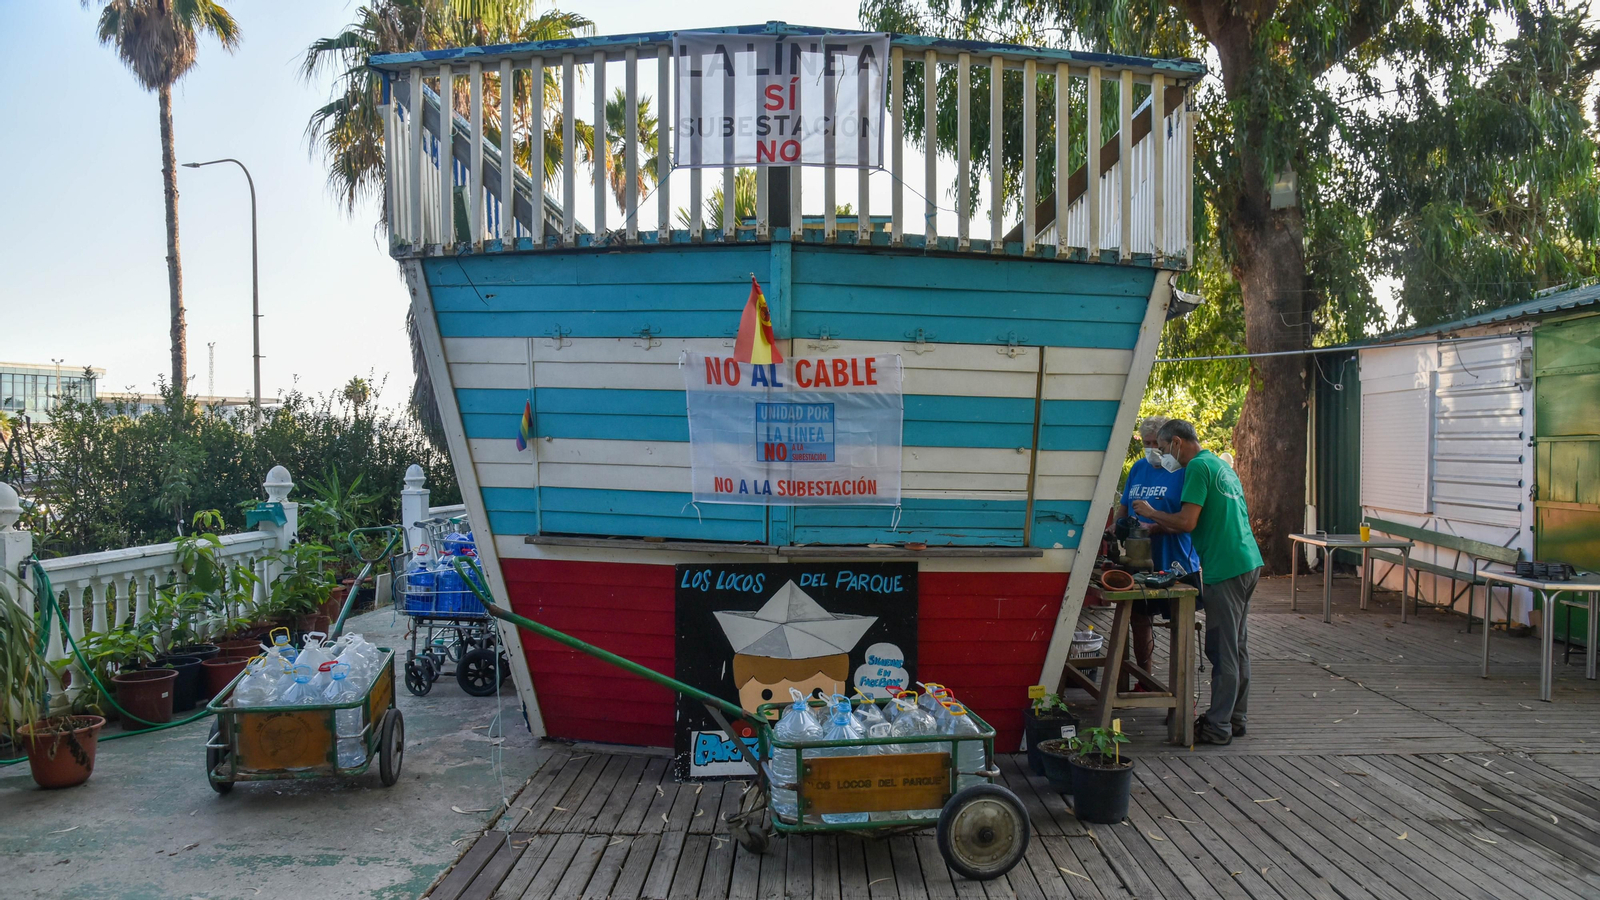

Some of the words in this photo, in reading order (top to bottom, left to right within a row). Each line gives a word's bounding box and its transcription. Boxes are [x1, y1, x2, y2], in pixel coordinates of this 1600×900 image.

[679, 43, 735, 77] LA
[746, 35, 881, 77] LÍNEA
[763, 77, 800, 111] SÍ
[679, 111, 878, 138] SUBESTACIÓN
[756, 139, 801, 163] NO
[704, 356, 741, 386] NO
[751, 363, 784, 388] AL
[795, 357, 878, 388] CABLE
[760, 406, 804, 420] UNIDAD
[807, 405, 829, 420] POR
[766, 427, 783, 442] LA
[787, 424, 825, 442] LÍNEA
[764, 442, 787, 461] NO
[791, 443, 797, 451] A
[797, 443, 804, 451] LA
[714, 476, 734, 493] NO
[738, 479, 749, 494] A
[753, 479, 772, 496] LA
[777, 476, 877, 497] SUBESTACIÓN
[680, 569, 712, 592] LOS
[715, 570, 766, 594] LOCOS
[799, 572, 829, 588] DEL
[835, 570, 904, 594] PARQUE
[837, 779, 872, 790] LOCOS
[878, 778, 898, 788] DEL
